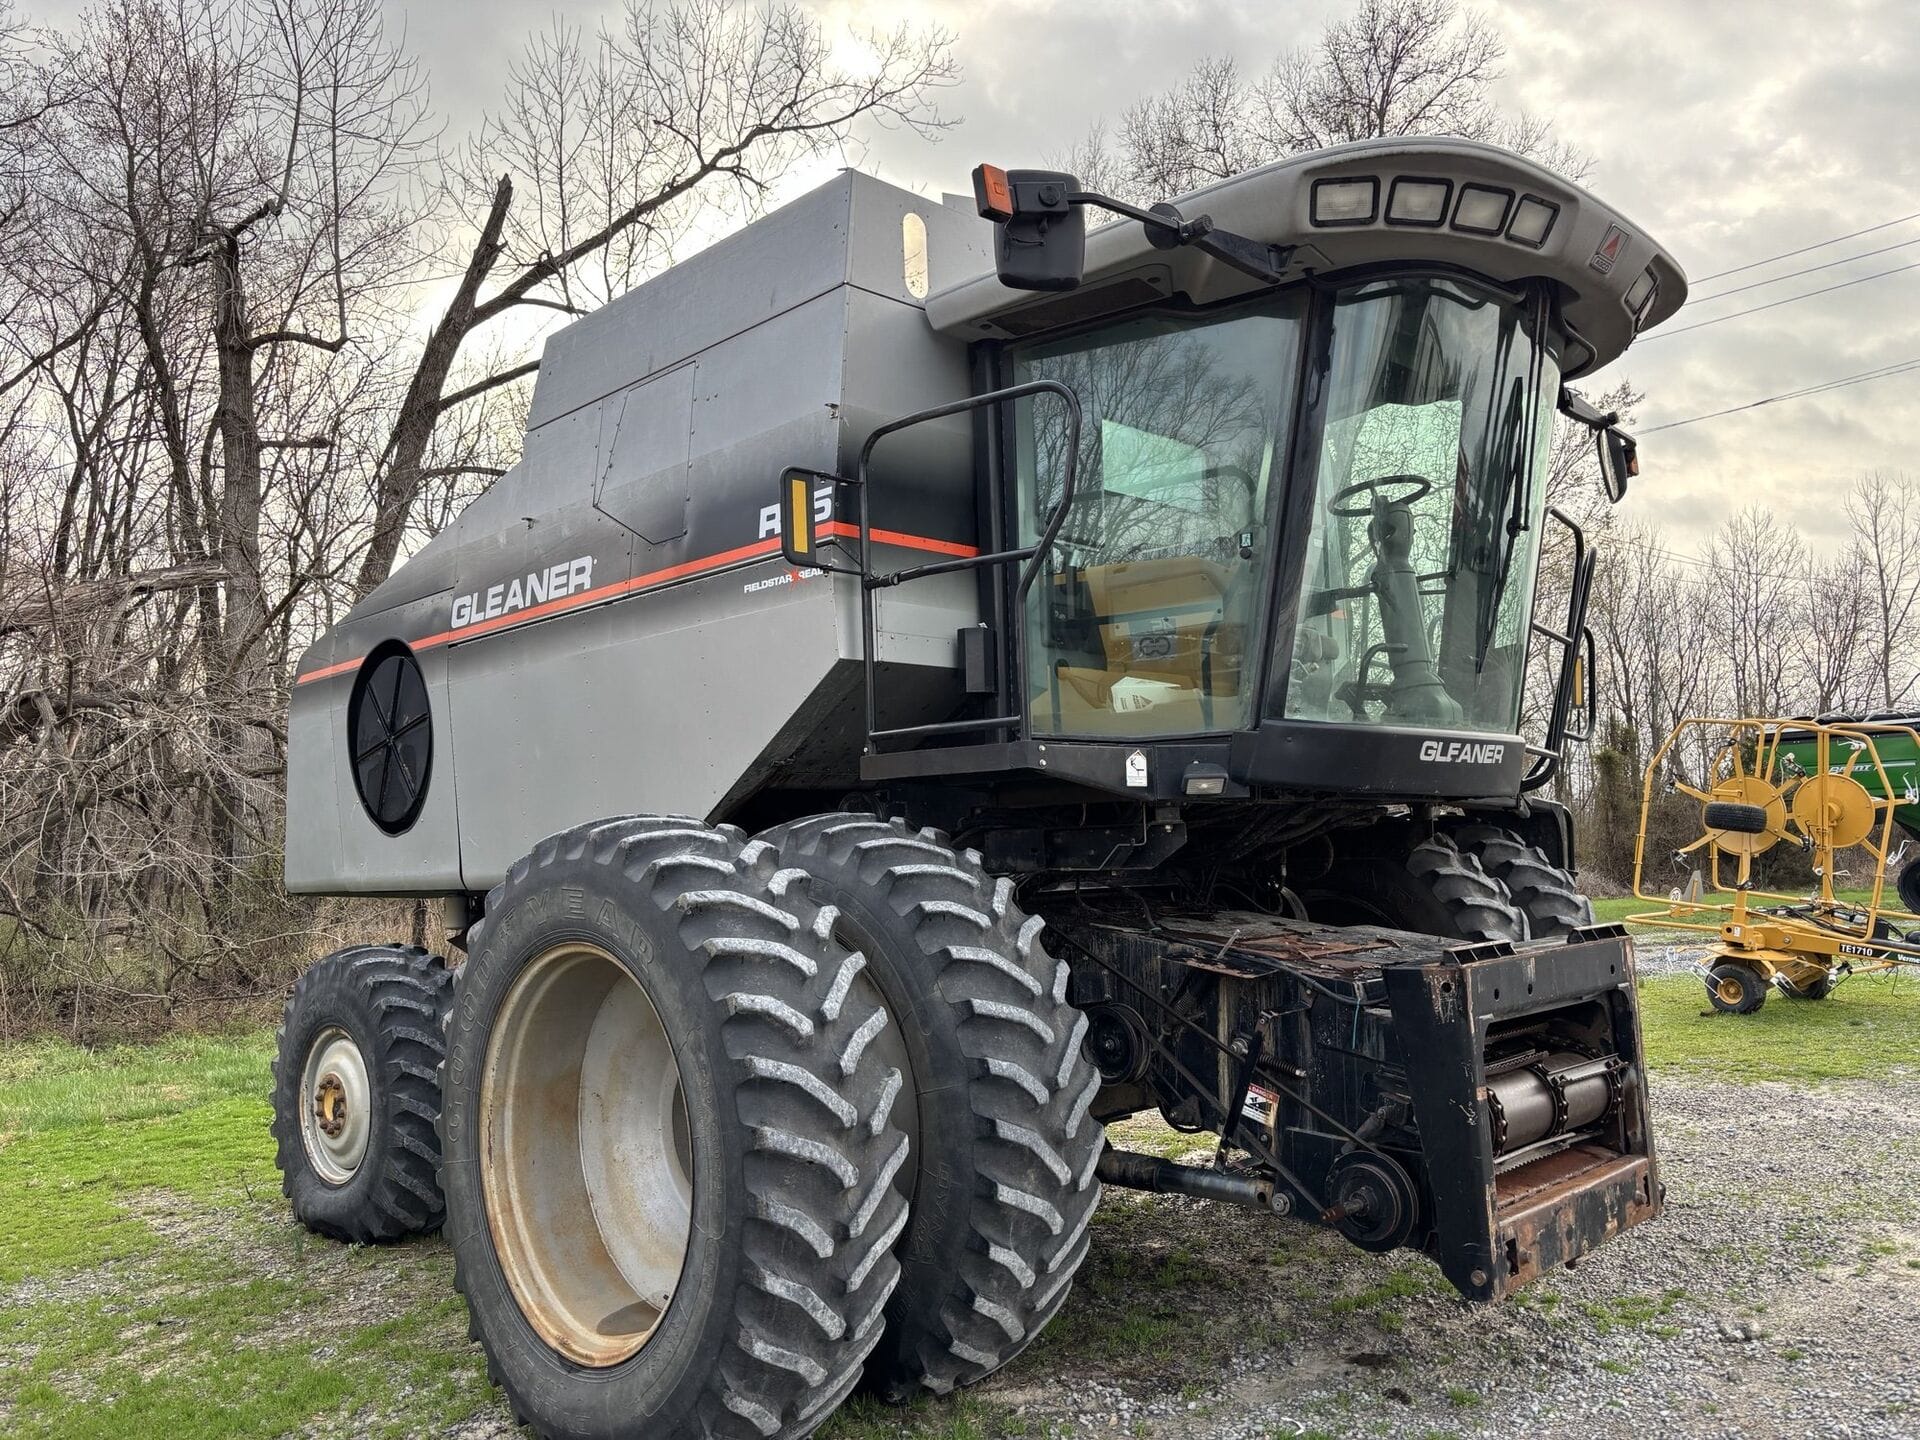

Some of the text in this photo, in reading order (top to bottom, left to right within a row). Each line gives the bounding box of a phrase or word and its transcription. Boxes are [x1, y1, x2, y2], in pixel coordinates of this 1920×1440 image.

[759, 486, 833, 539] R5
[451, 555, 593, 629] GLEANER
[744, 574, 793, 594] FIELDSTAR
[1840, 944, 1873, 956] TE1710
[448, 887, 655, 1143] GOODYEAR
